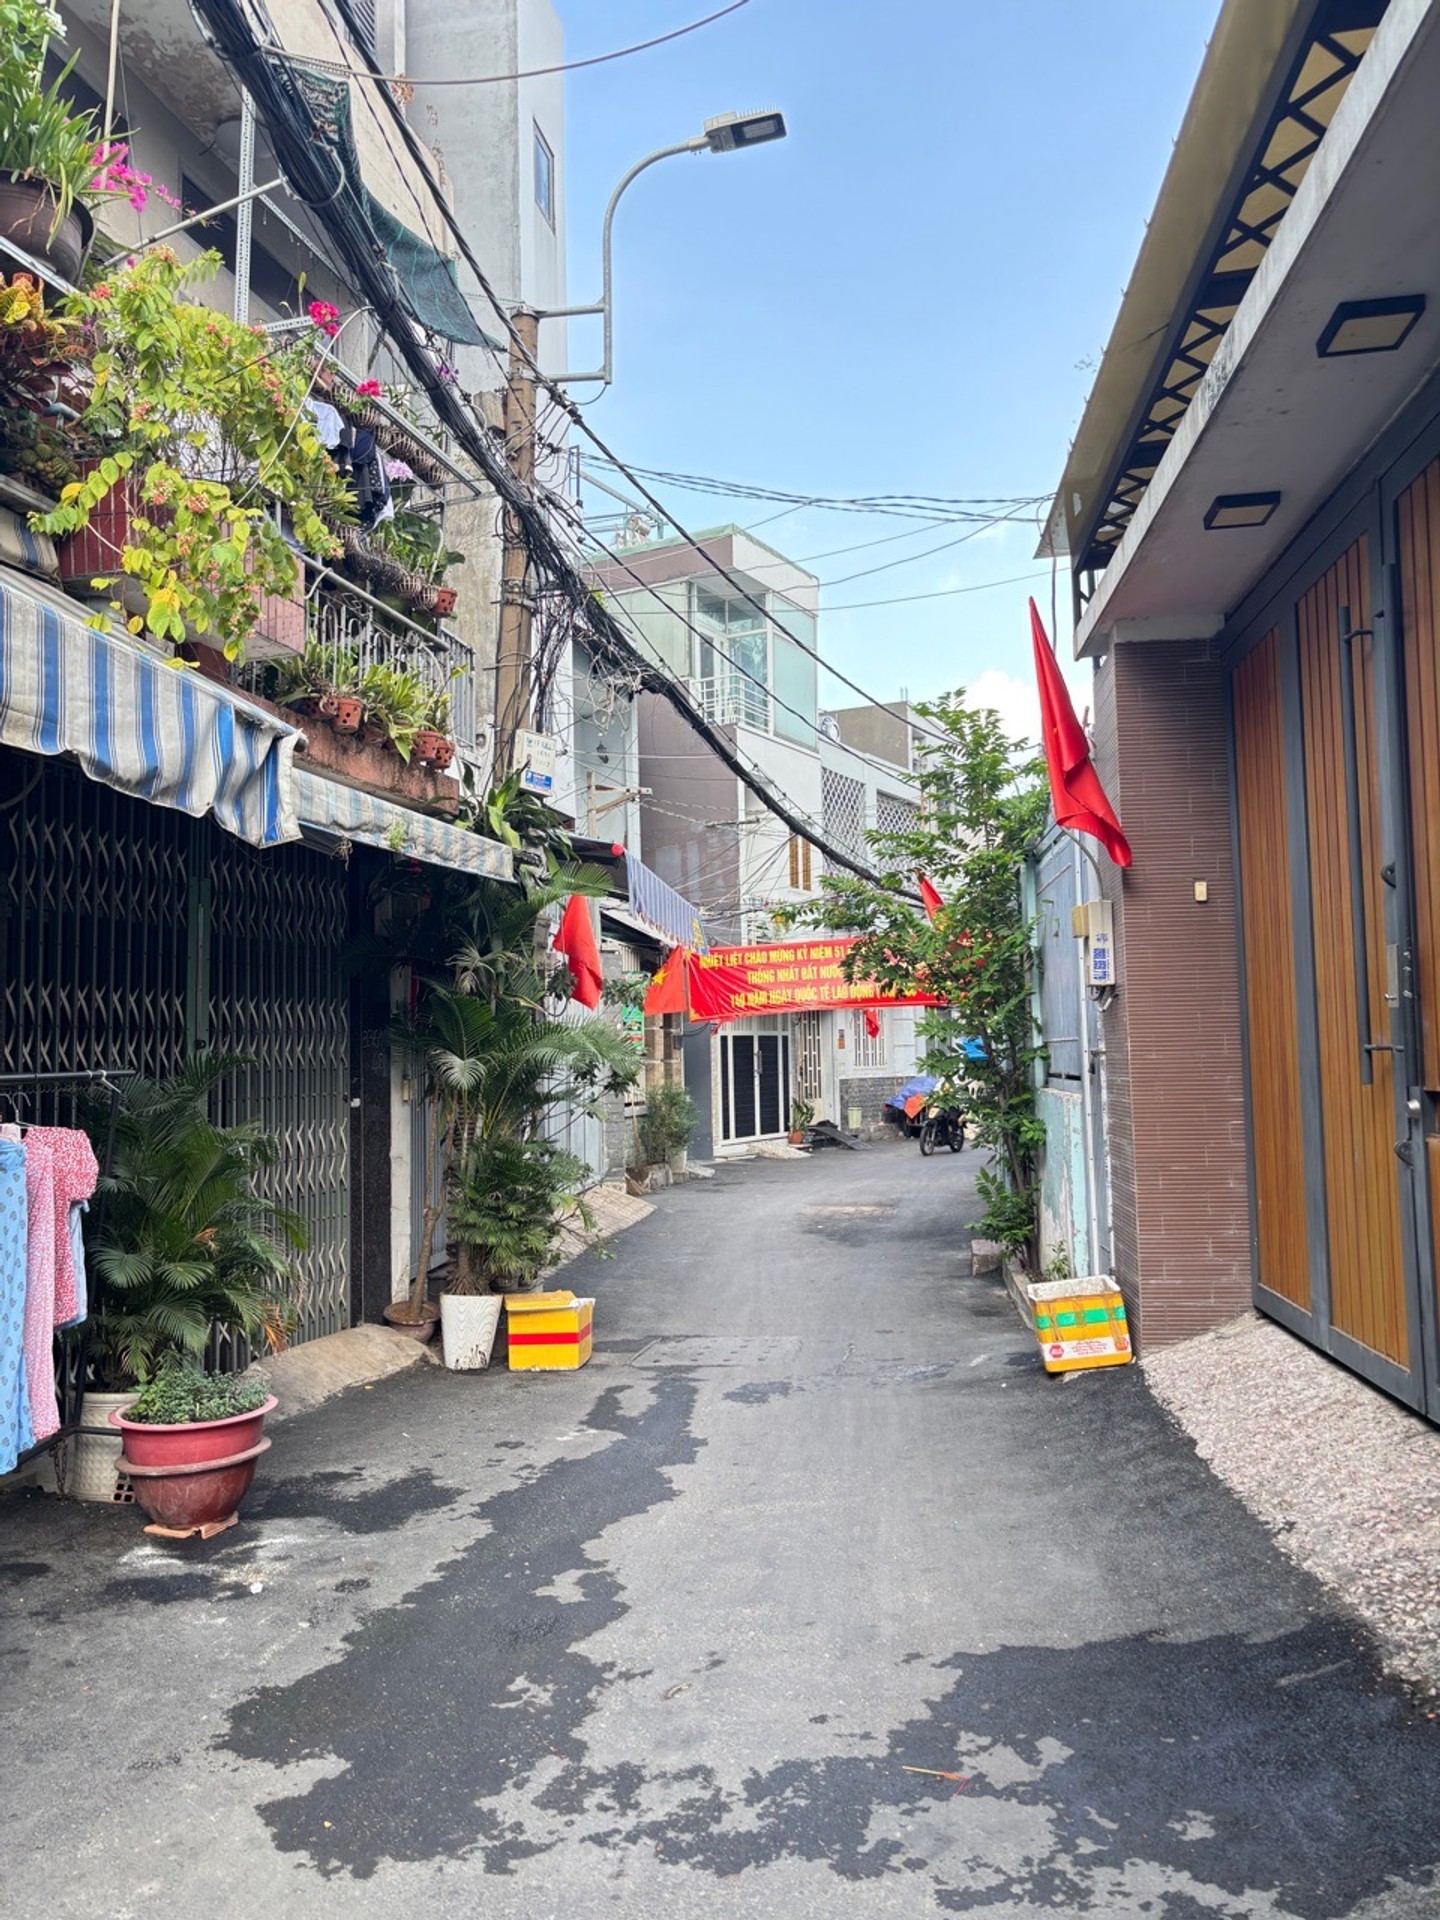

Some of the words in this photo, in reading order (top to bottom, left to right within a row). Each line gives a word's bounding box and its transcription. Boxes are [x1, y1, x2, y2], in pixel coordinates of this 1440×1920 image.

[725, 951, 742, 969] LIỆT
[810, 945, 833, 962] NIỆM
[834, 945, 845, 959] 51
[776, 963, 800, 983] NHẤT
[832, 984, 848, 1000] LAO
